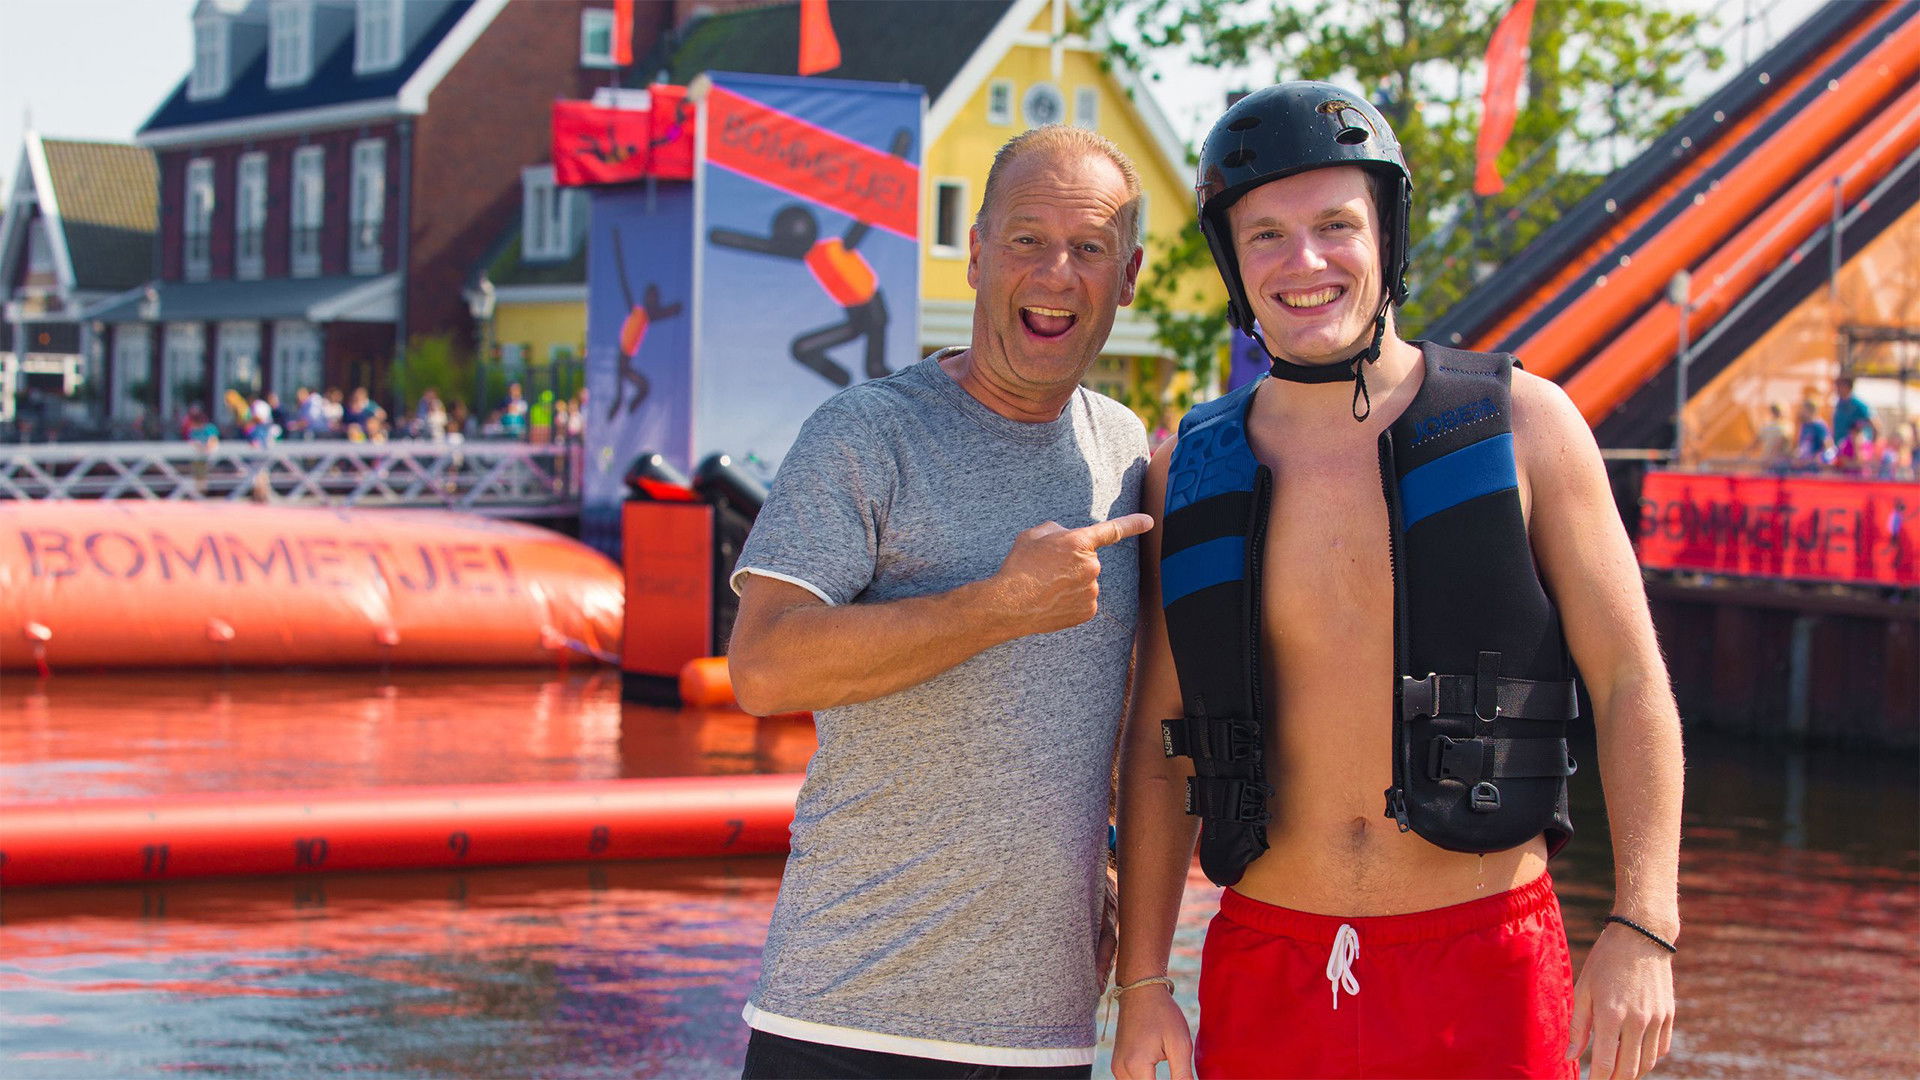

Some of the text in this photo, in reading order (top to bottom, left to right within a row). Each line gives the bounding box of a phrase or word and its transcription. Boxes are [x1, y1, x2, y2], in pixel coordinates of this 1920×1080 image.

[720, 113, 907, 212] BOMMETJE!
[1639, 498, 1862, 553] BOMMETJE!
[20, 529, 519, 594] BOMMETJE!
[141, 820, 745, 873] 11 10 9 8 7
